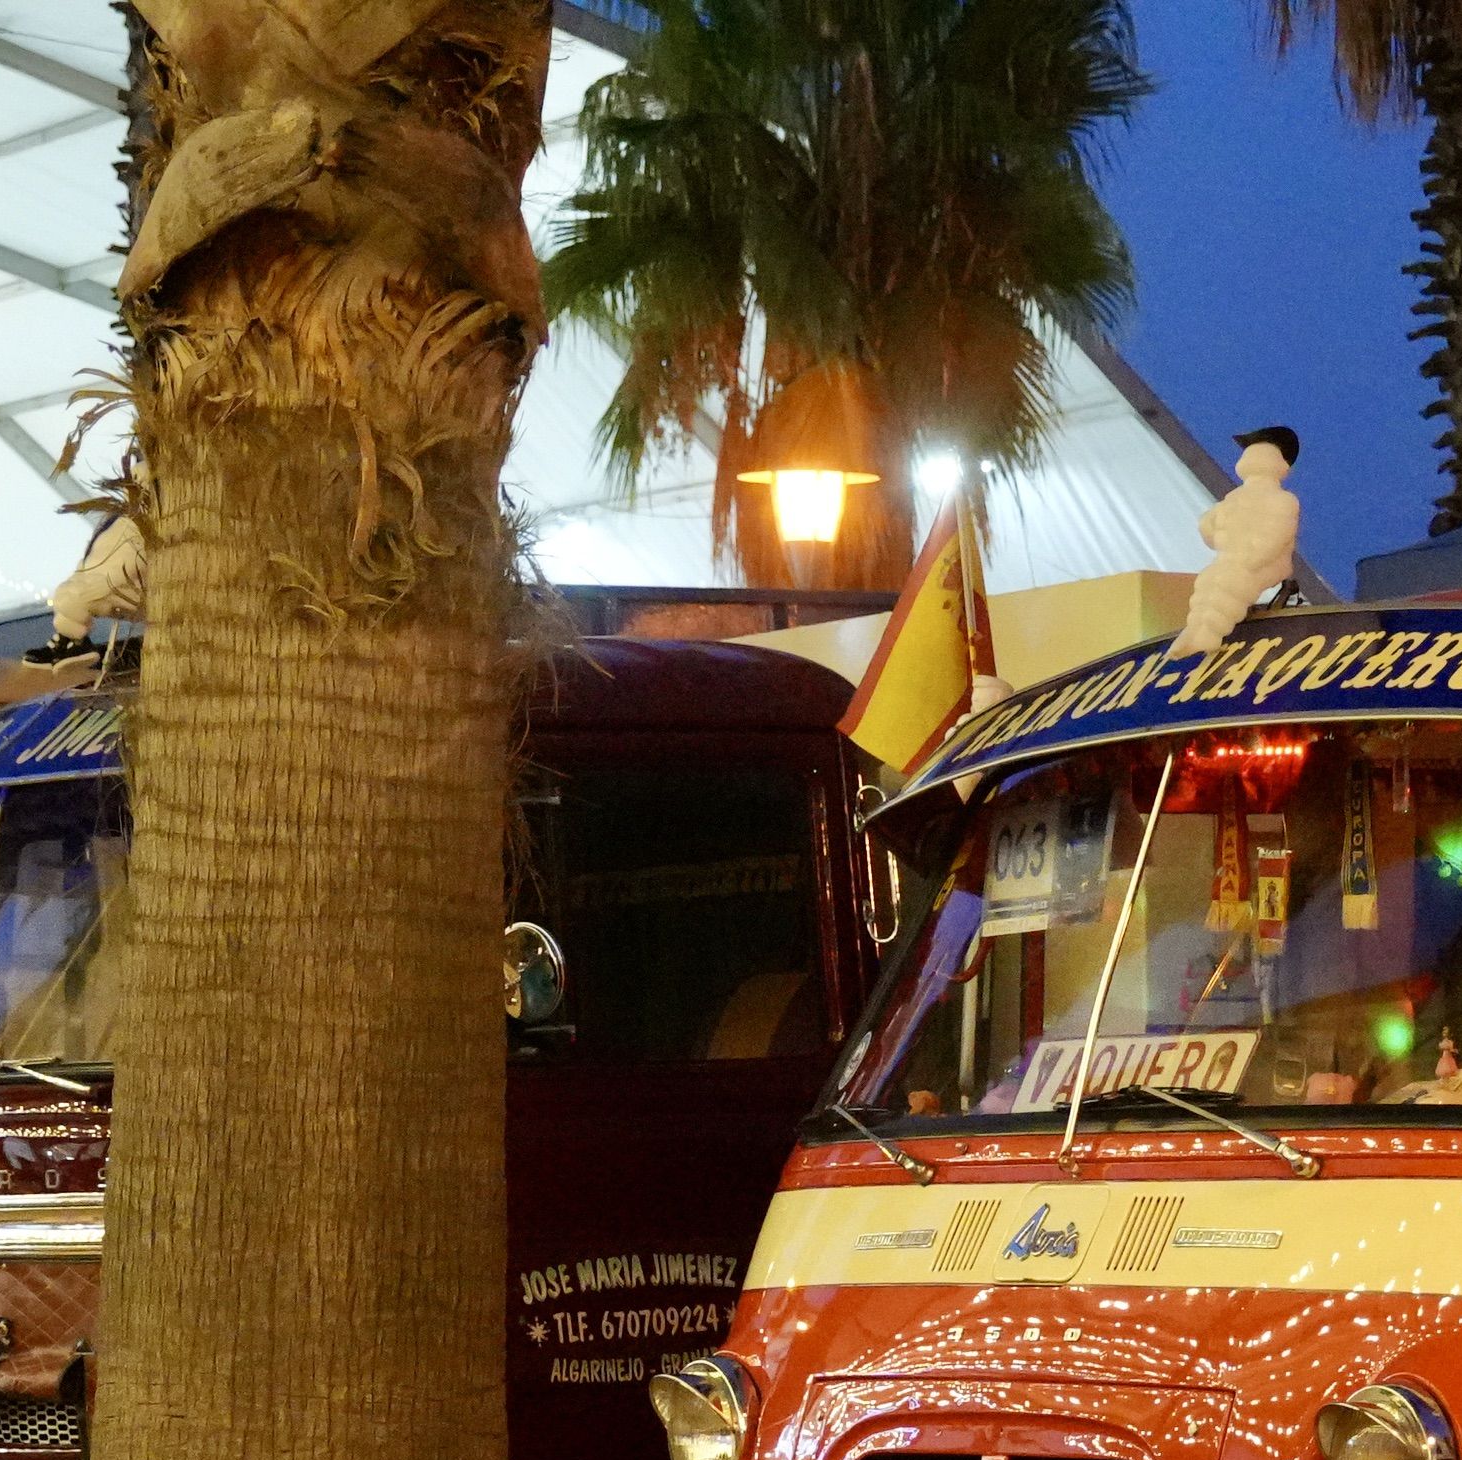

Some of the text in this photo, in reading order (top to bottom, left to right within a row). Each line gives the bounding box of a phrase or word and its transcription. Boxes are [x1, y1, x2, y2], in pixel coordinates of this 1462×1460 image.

[994, 822, 1047, 881] 063
[520, 1252, 737, 1305] JOSE MARIA JIMENEZ
[553, 1303, 720, 1344] TLF. 670709224
[550, 1357, 644, 1384] ALGARINEJO
